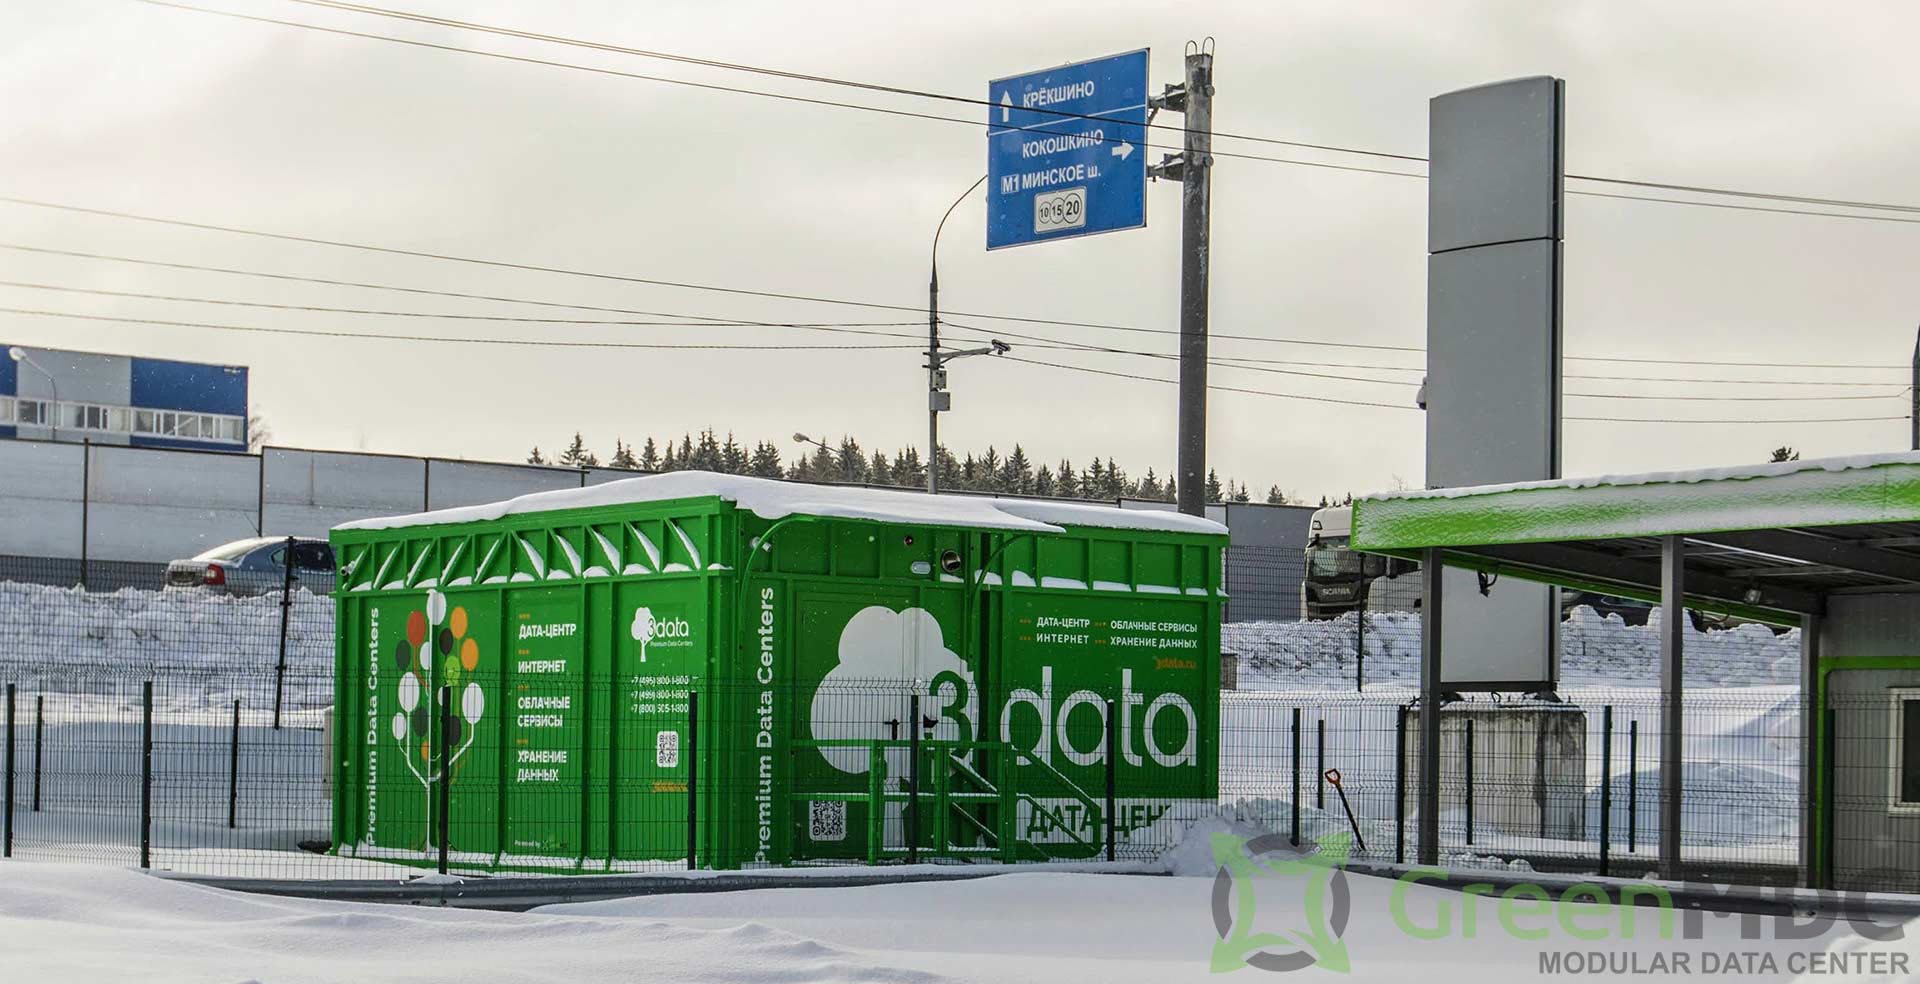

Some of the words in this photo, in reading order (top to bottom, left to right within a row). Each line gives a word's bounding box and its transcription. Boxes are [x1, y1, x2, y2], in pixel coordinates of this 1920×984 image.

[1023, 80, 1095, 109] КРЁКШИНО
[1022, 129, 1104, 159] КОКОШКИНО
[1022, 164, 1084, 190] МИНСКОЕ
[1087, 165, 1102, 178] ш.
[1040, 207, 1049, 218] 10
[1052, 204, 1062, 216] 15
[1066, 200, 1080, 216] 20
[1037, 617, 1090, 628] ДАТА-ЦЕНТР
[1110, 620, 1157, 631] ОБЛАЧНЫЕ
[1158, 622, 1198, 633] СЕРВИСЫ
[519, 623, 577, 640] ДАТА-ЦЕНТР
[757, 587, 774, 685] Centers
[1036, 634, 1089, 644] ИНТЕРНЕТ
[368, 607, 379, 690] Centers
[1110, 636, 1157, 647] ХРАНЕНИЕ
[1158, 638, 1198, 648] ДАННЫХ
[518, 660, 566, 673] ИНТЕРНЕТ
[518, 696, 571, 709] ОБЛАЧНЫЕ
[367, 695, 377, 745] Data
[517, 714, 563, 727] СЕРВИСЫ
[756, 690, 773, 748] Data
[518, 750, 567, 764] ХРАНЕНИЕ
[517, 768, 560, 782] ДАННЫХ
[366, 750, 377, 847] Premium
[755, 754, 772, 865] Premium
